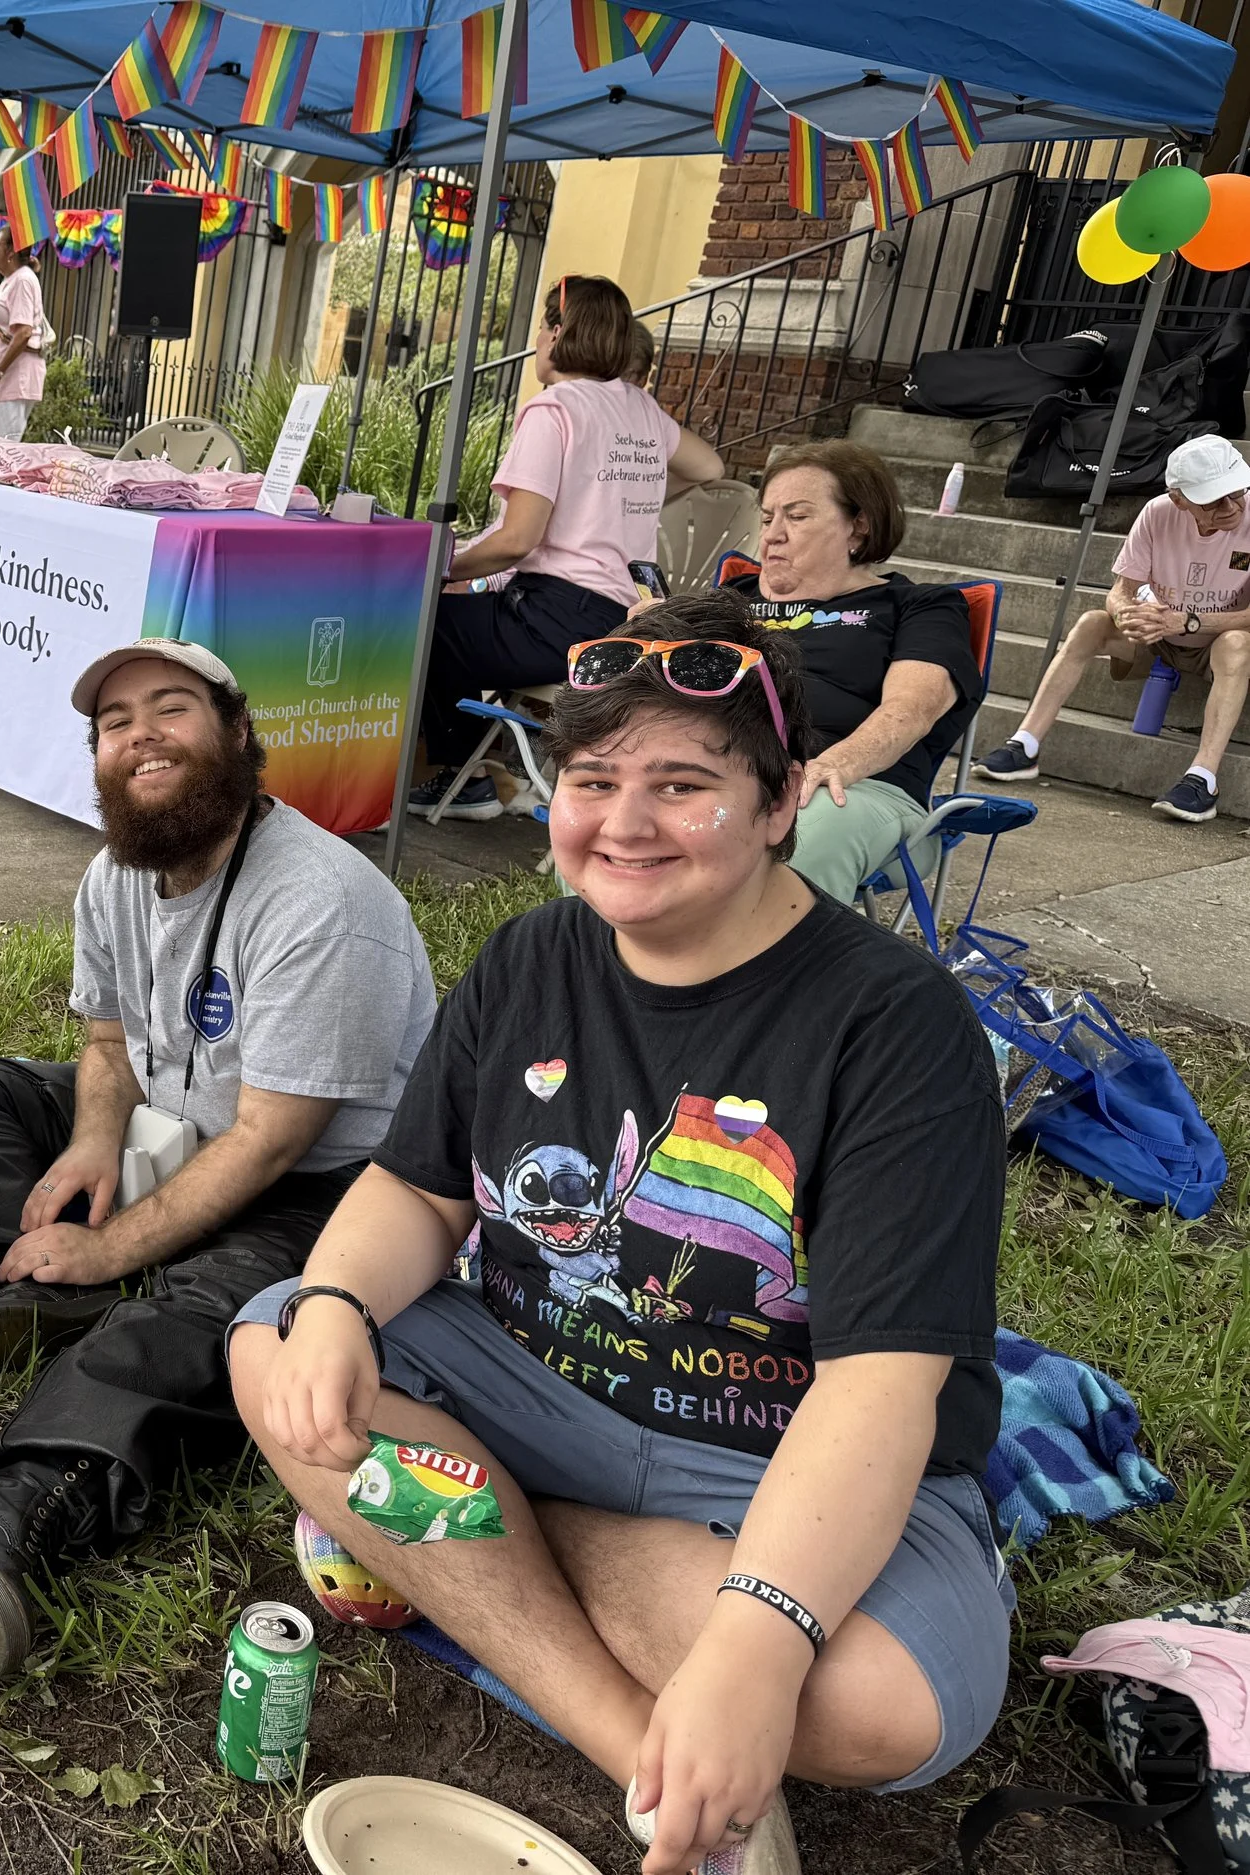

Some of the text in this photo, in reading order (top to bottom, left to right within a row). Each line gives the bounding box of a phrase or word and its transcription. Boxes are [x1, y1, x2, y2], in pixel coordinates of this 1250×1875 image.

[608, 450, 632, 463] Show
[1183, 587, 1244, 603] FORUM
[1186, 599, 1238, 614] Shepherd
[250, 692, 401, 721] piscopal Church of the
[256, 712, 398, 748] ood Shepherd
[537, 1299, 648, 1362] MEANS
[672, 1344, 809, 1385] NOBOD
[544, 1346, 795, 1431] LEFT BEHIND
[756, 1583, 813, 1629] BLACK
